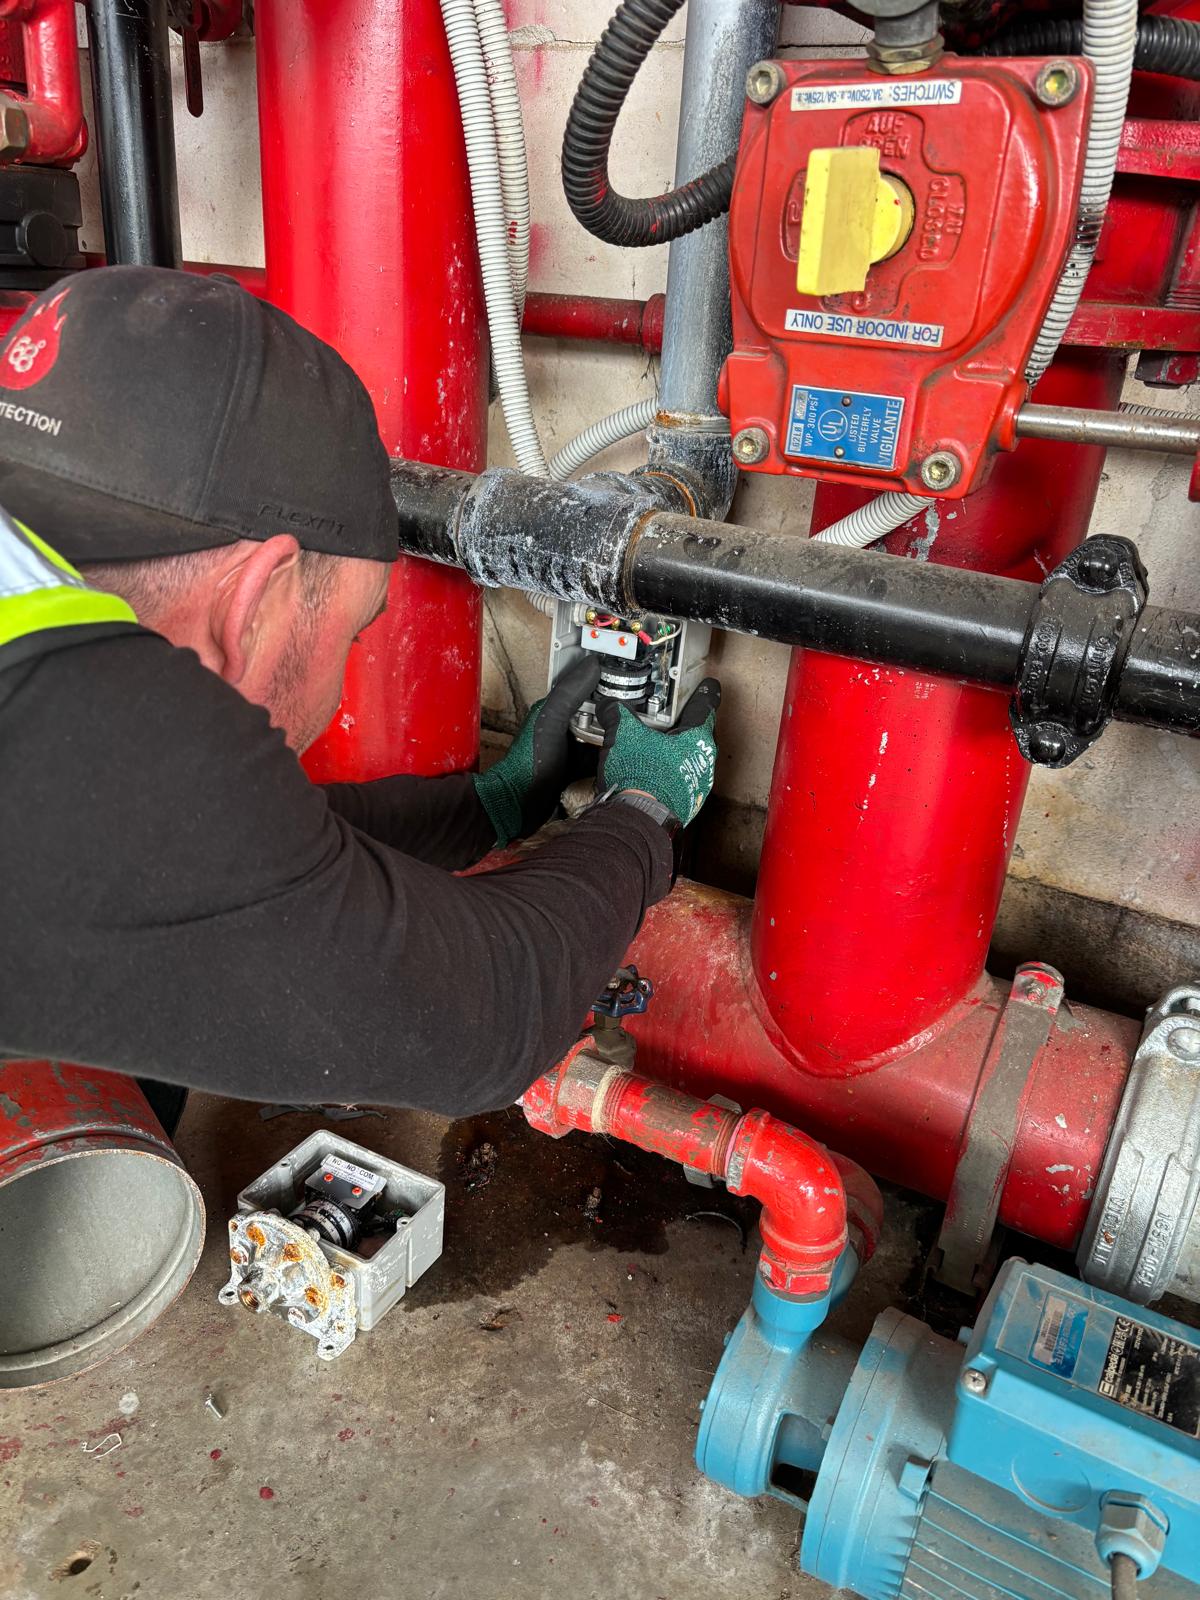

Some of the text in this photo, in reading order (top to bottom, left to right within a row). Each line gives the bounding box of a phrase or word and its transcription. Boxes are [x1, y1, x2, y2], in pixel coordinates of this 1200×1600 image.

[890, 84, 955, 101] SWITCHES:
[790, 312, 941, 343] FOR INDOOR USE ONLY
[821, 416, 845, 435] UL
[849, 414, 860, 442] LISTED
[857, 406, 872, 453] BUTTERFLY
[870, 418, 881, 443] VALVE
[877, 400, 900, 466] VIGILANTE
[331, 1158, 375, 1181] NC NO COM
[1104, 1353, 1120, 1383] calpeda
